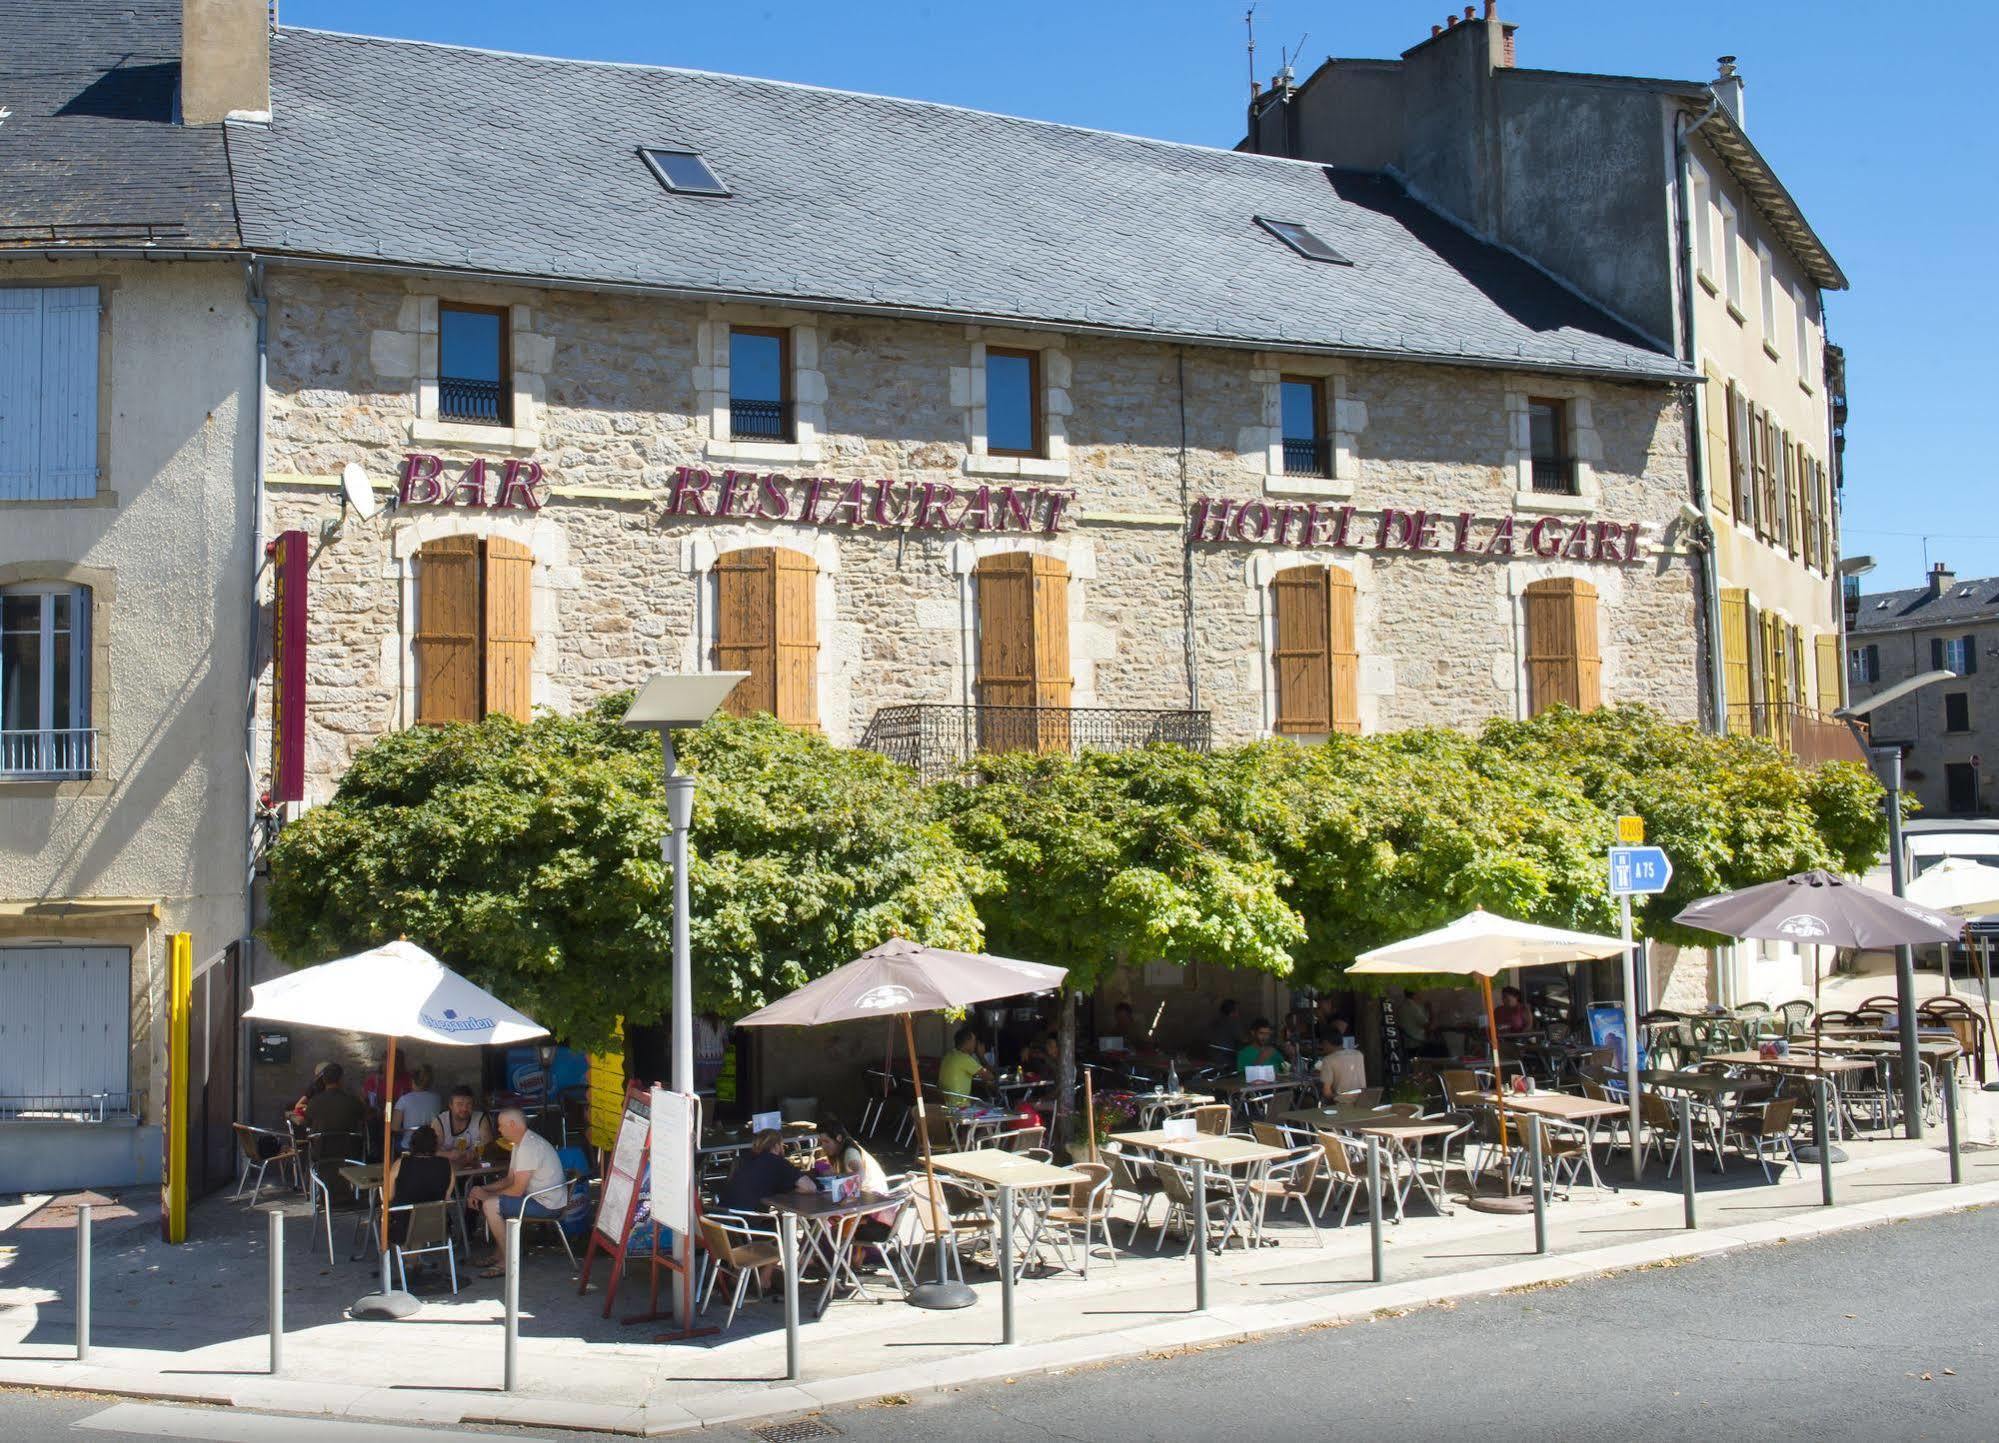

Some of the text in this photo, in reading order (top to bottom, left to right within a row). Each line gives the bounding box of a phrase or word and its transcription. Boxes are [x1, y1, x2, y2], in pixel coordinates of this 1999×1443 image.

[400, 453, 543, 511] BAR
[666, 466, 1076, 533] RESTAURANT
[1191, 495, 1364, 548] HOTEL
[1377, 506, 1442, 551] DE
[1453, 512, 1515, 556] LA
[1635, 861, 1655, 879] A 75
